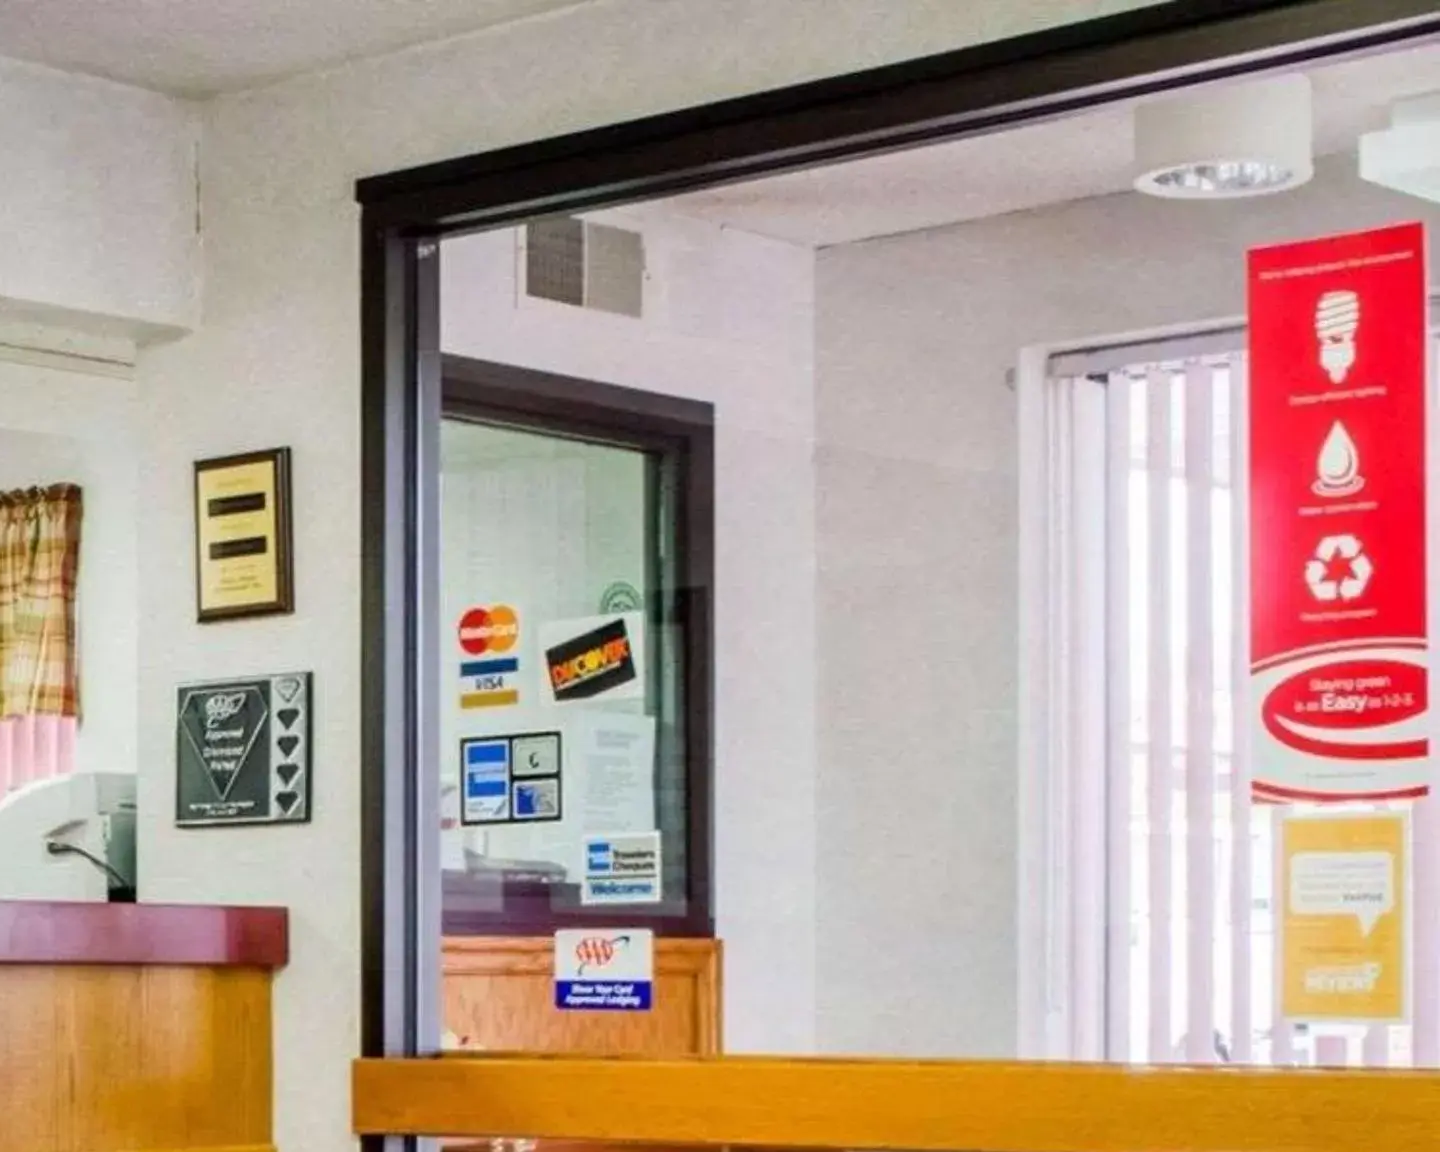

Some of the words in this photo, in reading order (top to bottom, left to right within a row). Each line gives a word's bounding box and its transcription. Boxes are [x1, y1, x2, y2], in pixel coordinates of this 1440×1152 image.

[475, 675, 504, 690] VISA
[1322, 693, 1367, 713] Easy
[591, 881, 653, 896] Welcome
